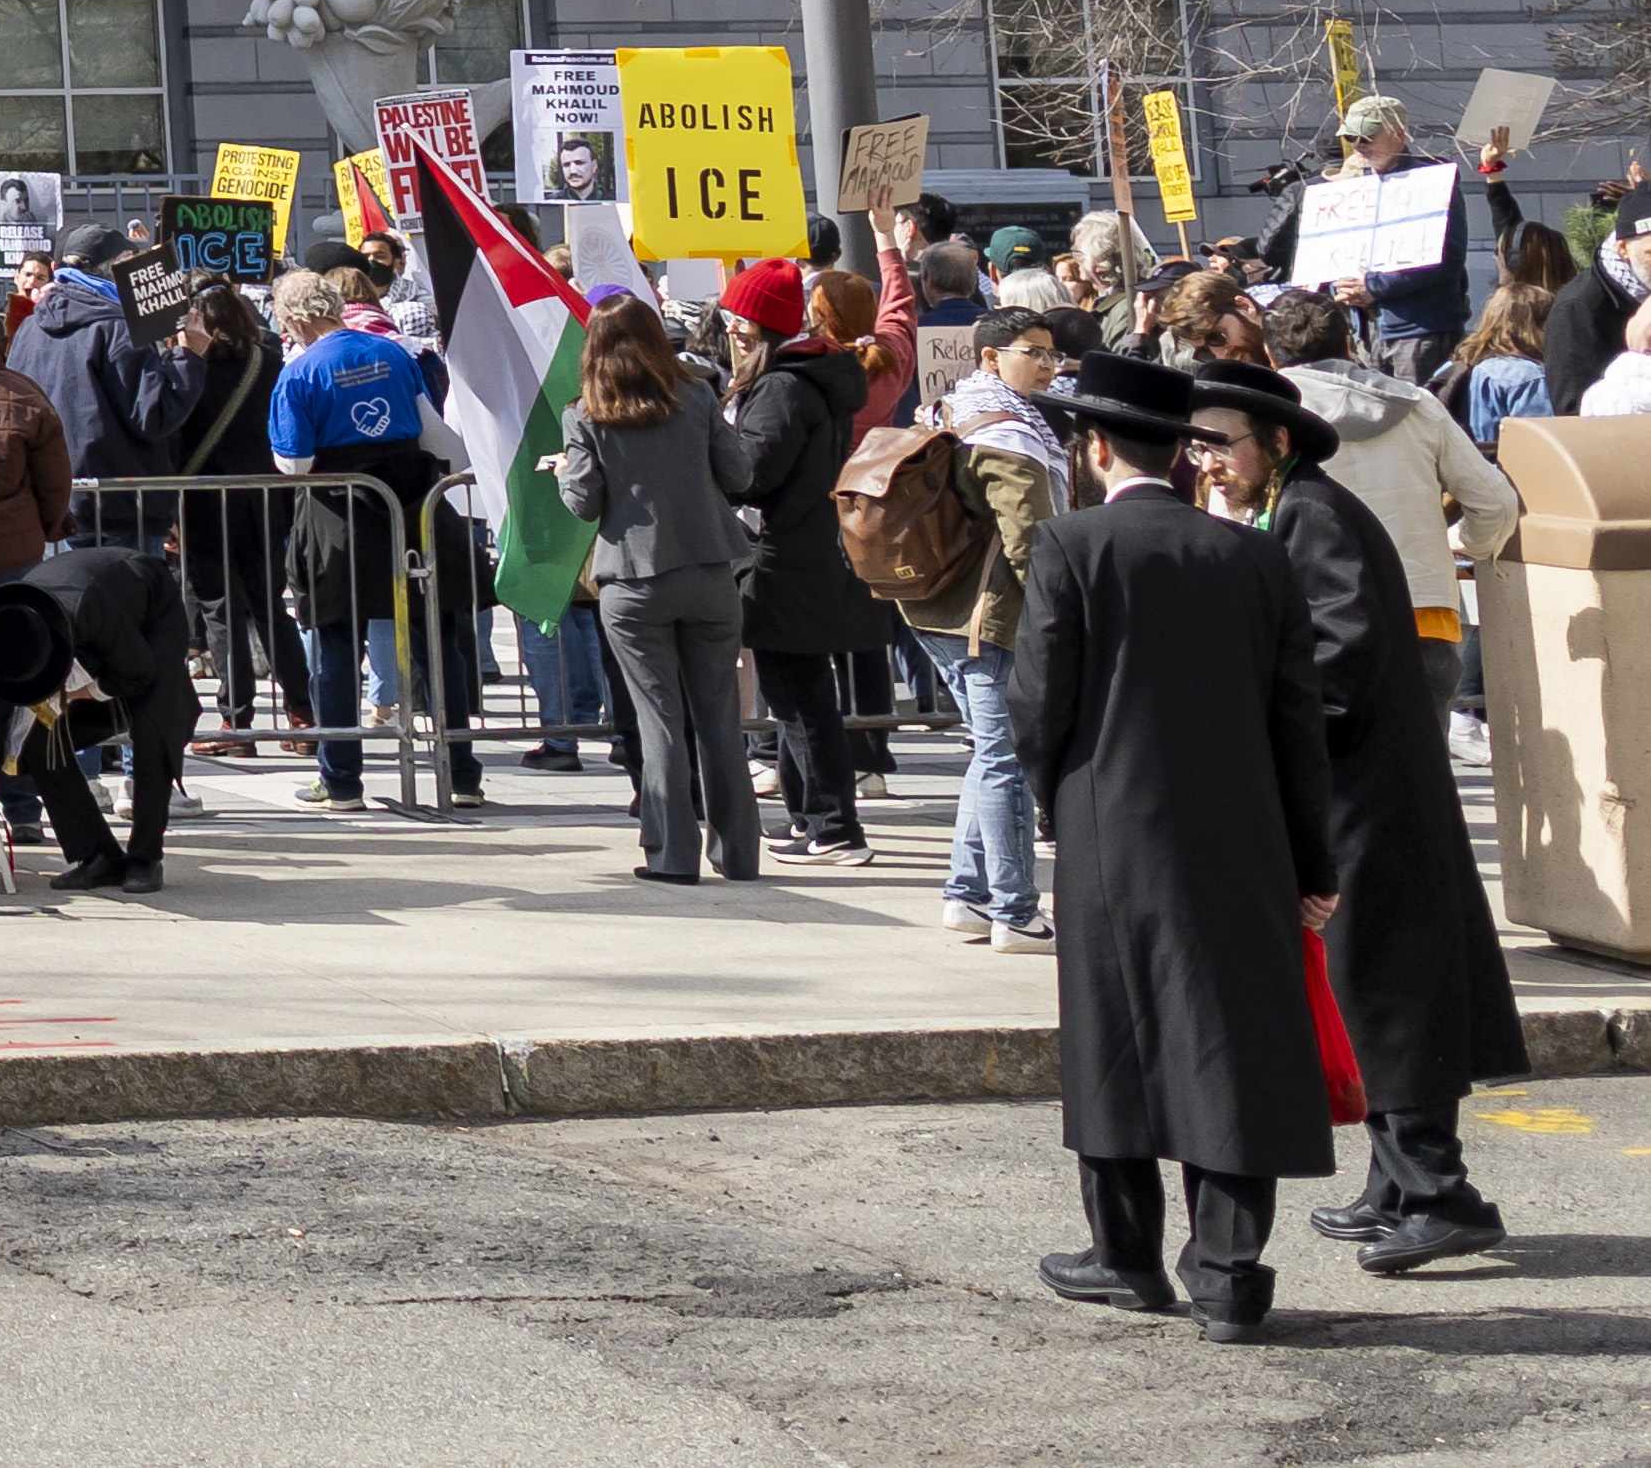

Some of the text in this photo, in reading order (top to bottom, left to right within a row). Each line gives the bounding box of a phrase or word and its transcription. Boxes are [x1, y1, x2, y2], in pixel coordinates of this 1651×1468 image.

[532, 55, 614, 64] RefuseFascism.org
[554, 71, 596, 81] FREE
[532, 85, 619, 95] MAHMOUD
[378, 99, 471, 133] PALESTINE
[546, 99, 607, 109] KHALIL
[555, 113, 598, 123] NOW!
[639, 103, 774, 133] ABOLISH
[444, 125, 477, 157] BE
[853, 125, 918, 165] FREE
[221, 149, 295, 170] PROTESTING
[219, 165, 293, 181] AGAINST
[842, 153, 921, 195] MAHMOUD
[217, 177, 290, 201] GENOCIDE
[177, 204, 273, 233] ABOLISH
[1315, 189, 1377, 227] FREE
[0, 226, 44, 239] RELEASE
[0, 239, 52, 252] MAHMOUD
[178, 231, 267, 273] ICE
[129, 262, 165, 287] FREE
[133, 271, 183, 302] MAHMO
[137, 288, 187, 317] KHALIL
[926, 337, 976, 361] Relea
